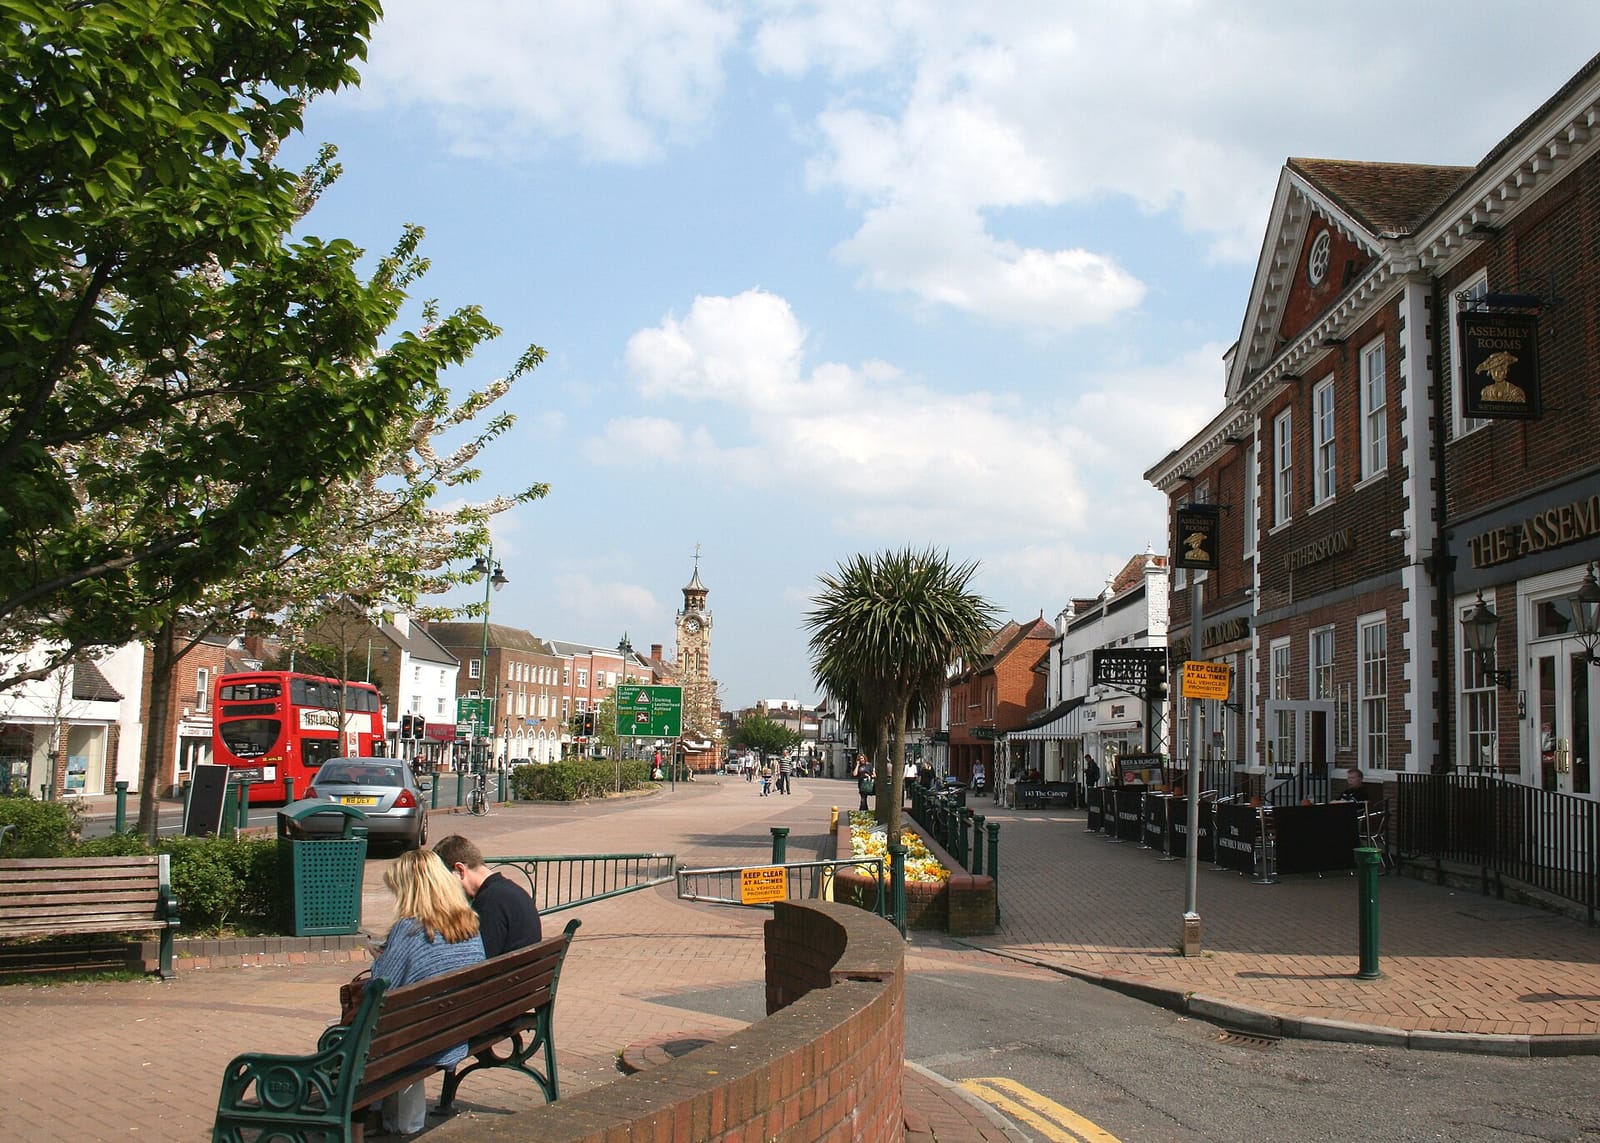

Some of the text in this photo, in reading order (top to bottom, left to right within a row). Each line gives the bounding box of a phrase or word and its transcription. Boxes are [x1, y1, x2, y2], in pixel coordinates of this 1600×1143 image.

[1468, 326, 1530, 338] ASSEMBLY
[1478, 338, 1522, 350] ROOMS
[1283, 528, 1353, 571] WETHERSPOON
[1467, 527, 1511, 569] THE
[1187, 664, 1227, 674] KEEP CLEAR
[1047, 790, 1069, 798] Canopy
[743, 870, 783, 879] KEEP CLEAR
